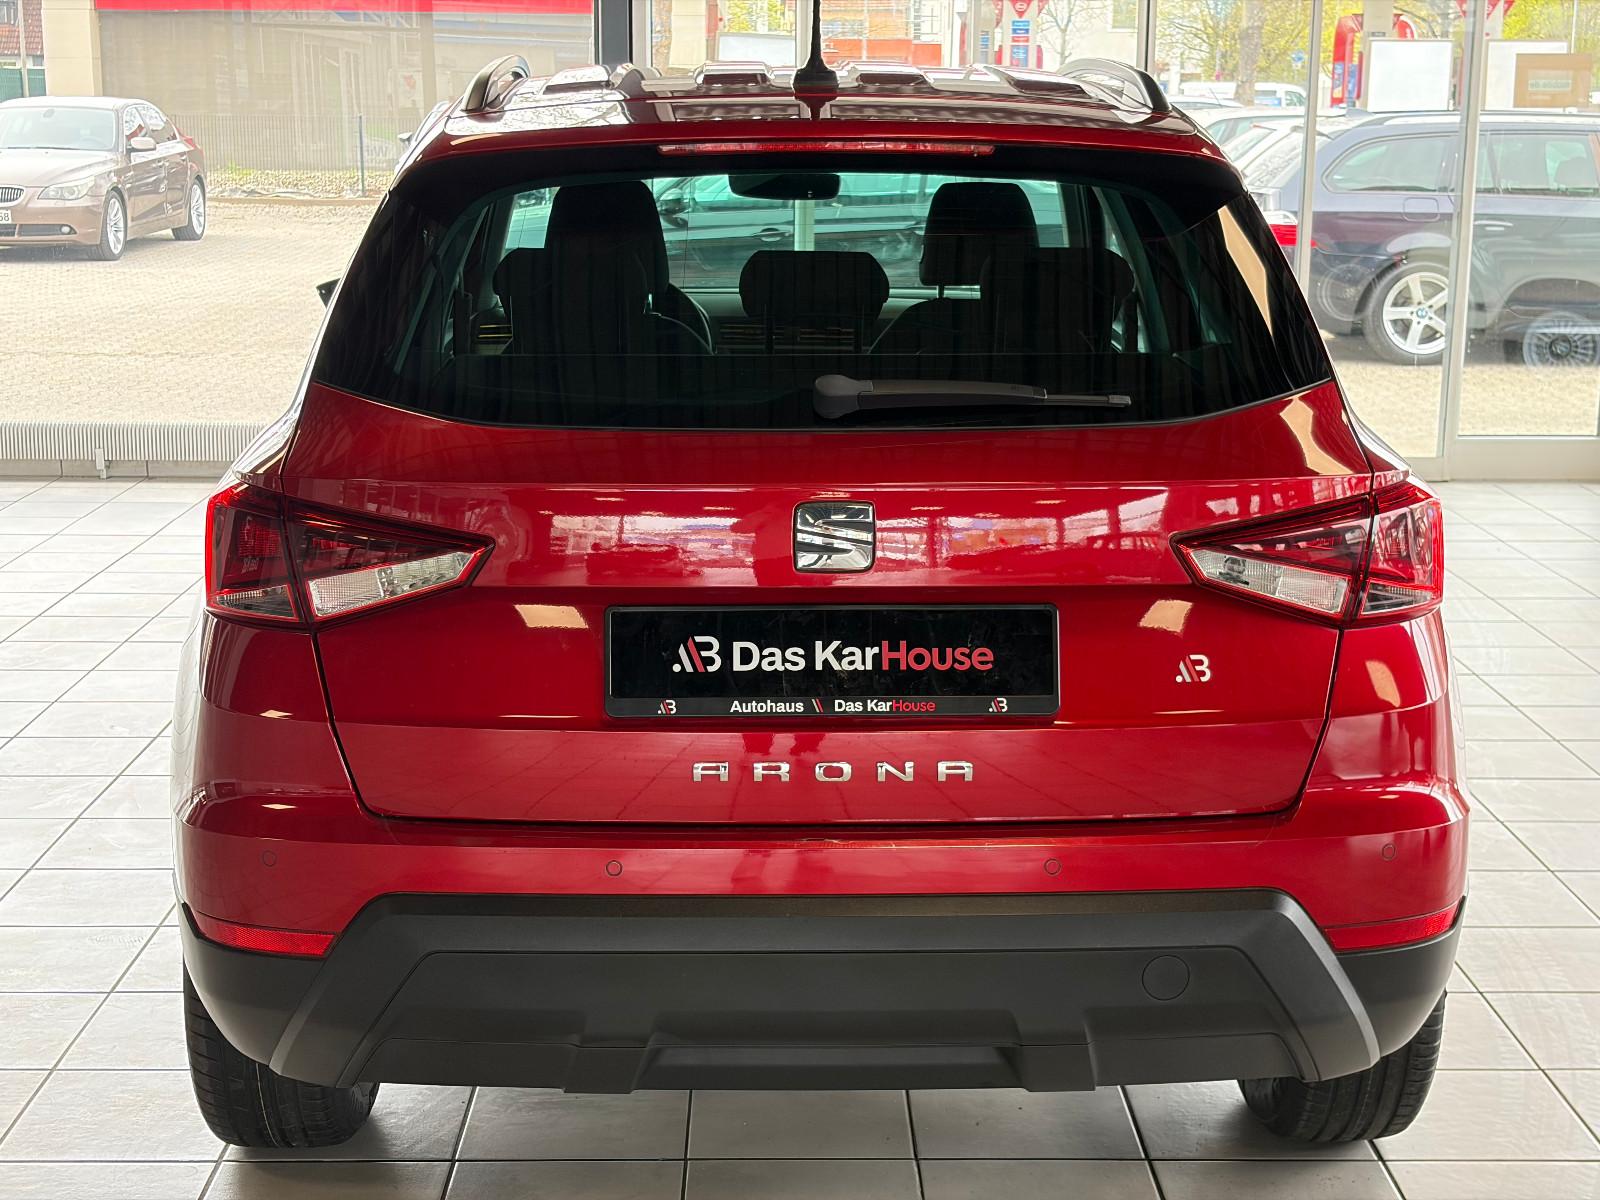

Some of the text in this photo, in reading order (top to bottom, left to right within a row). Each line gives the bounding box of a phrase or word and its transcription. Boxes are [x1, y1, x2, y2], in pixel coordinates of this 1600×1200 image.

[732, 640, 806, 672] Das
[814, 640, 994, 672] KarHouse
[729, 699, 936, 713] Autohaus Das KarHouse
[692, 761, 974, 783] ARONA
